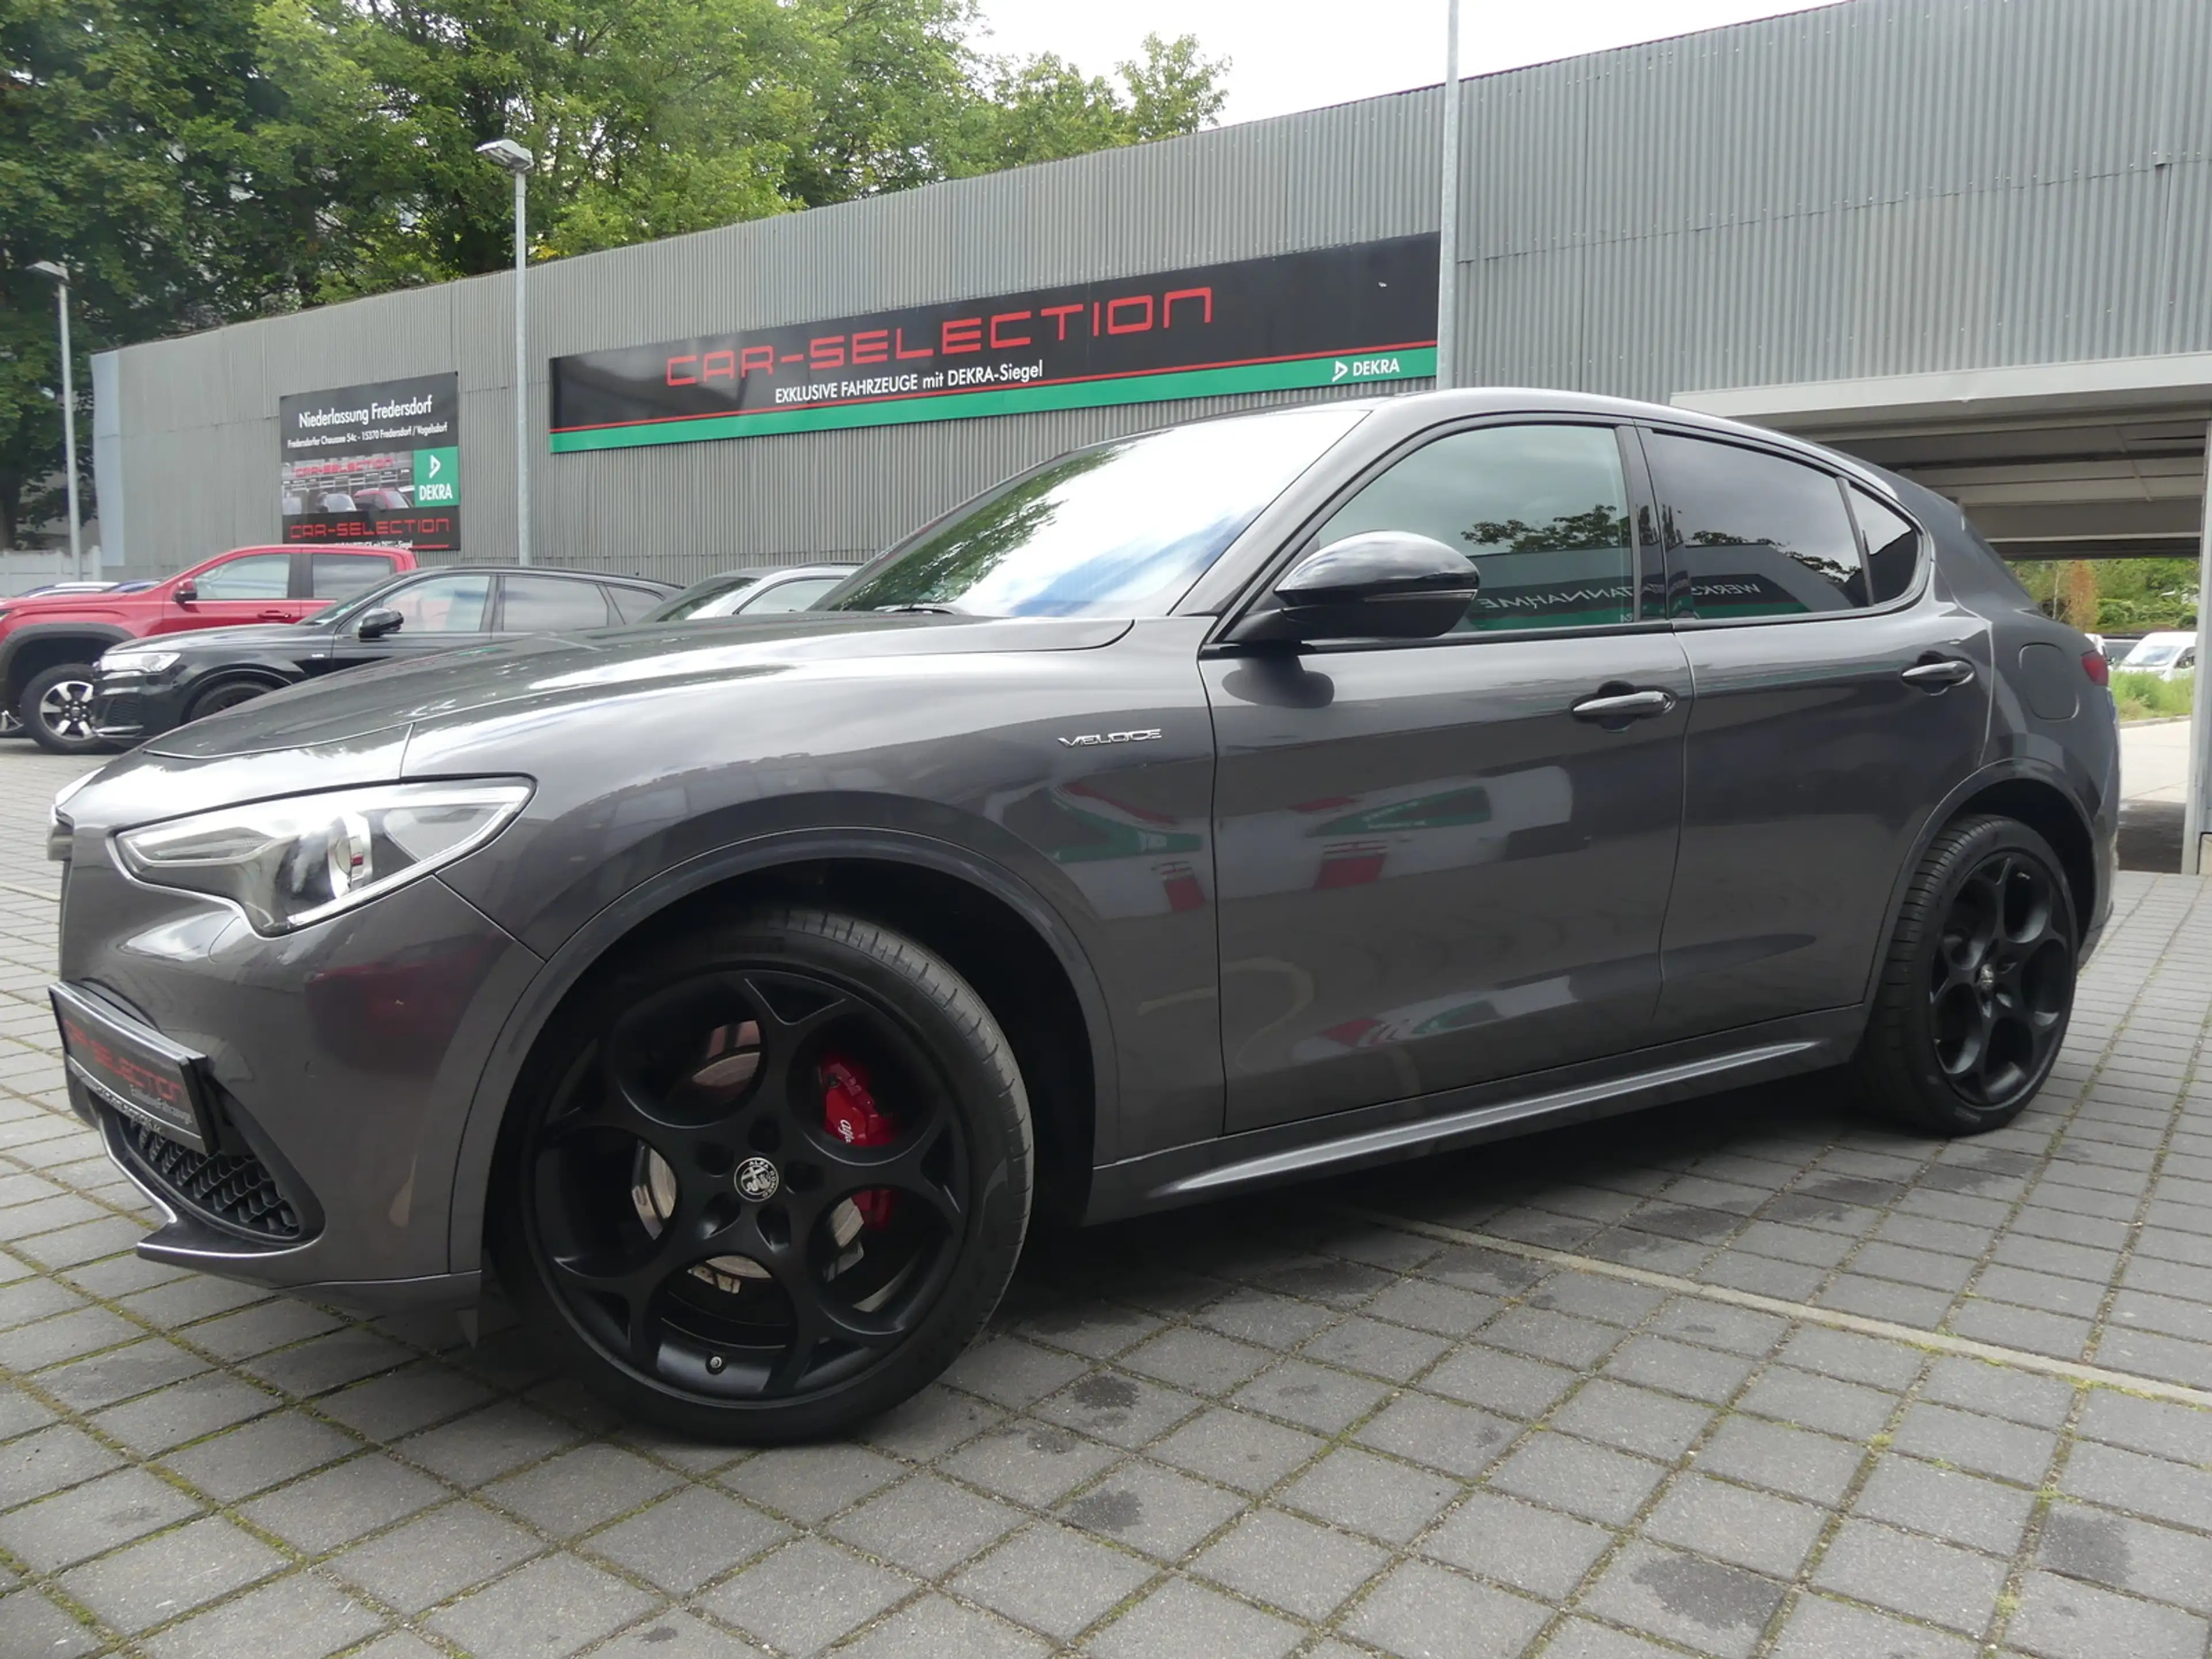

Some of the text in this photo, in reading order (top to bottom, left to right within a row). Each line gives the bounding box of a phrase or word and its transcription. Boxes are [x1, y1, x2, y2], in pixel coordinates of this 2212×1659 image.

[666, 286, 1212, 387] CAR-SELECTION
[1353, 357, 1400, 376] DEKRA
[775, 359, 1043, 403] EXKLUSIVE FAHRZEUGE mit DEKRA-Siegel
[298, 394, 432, 429] Niederlassung Fredersdorf
[419, 483, 453, 501] DEKRA
[290, 518, 449, 539] CAR-SELECTION
[1058, 728, 1162, 748] VELOCE
